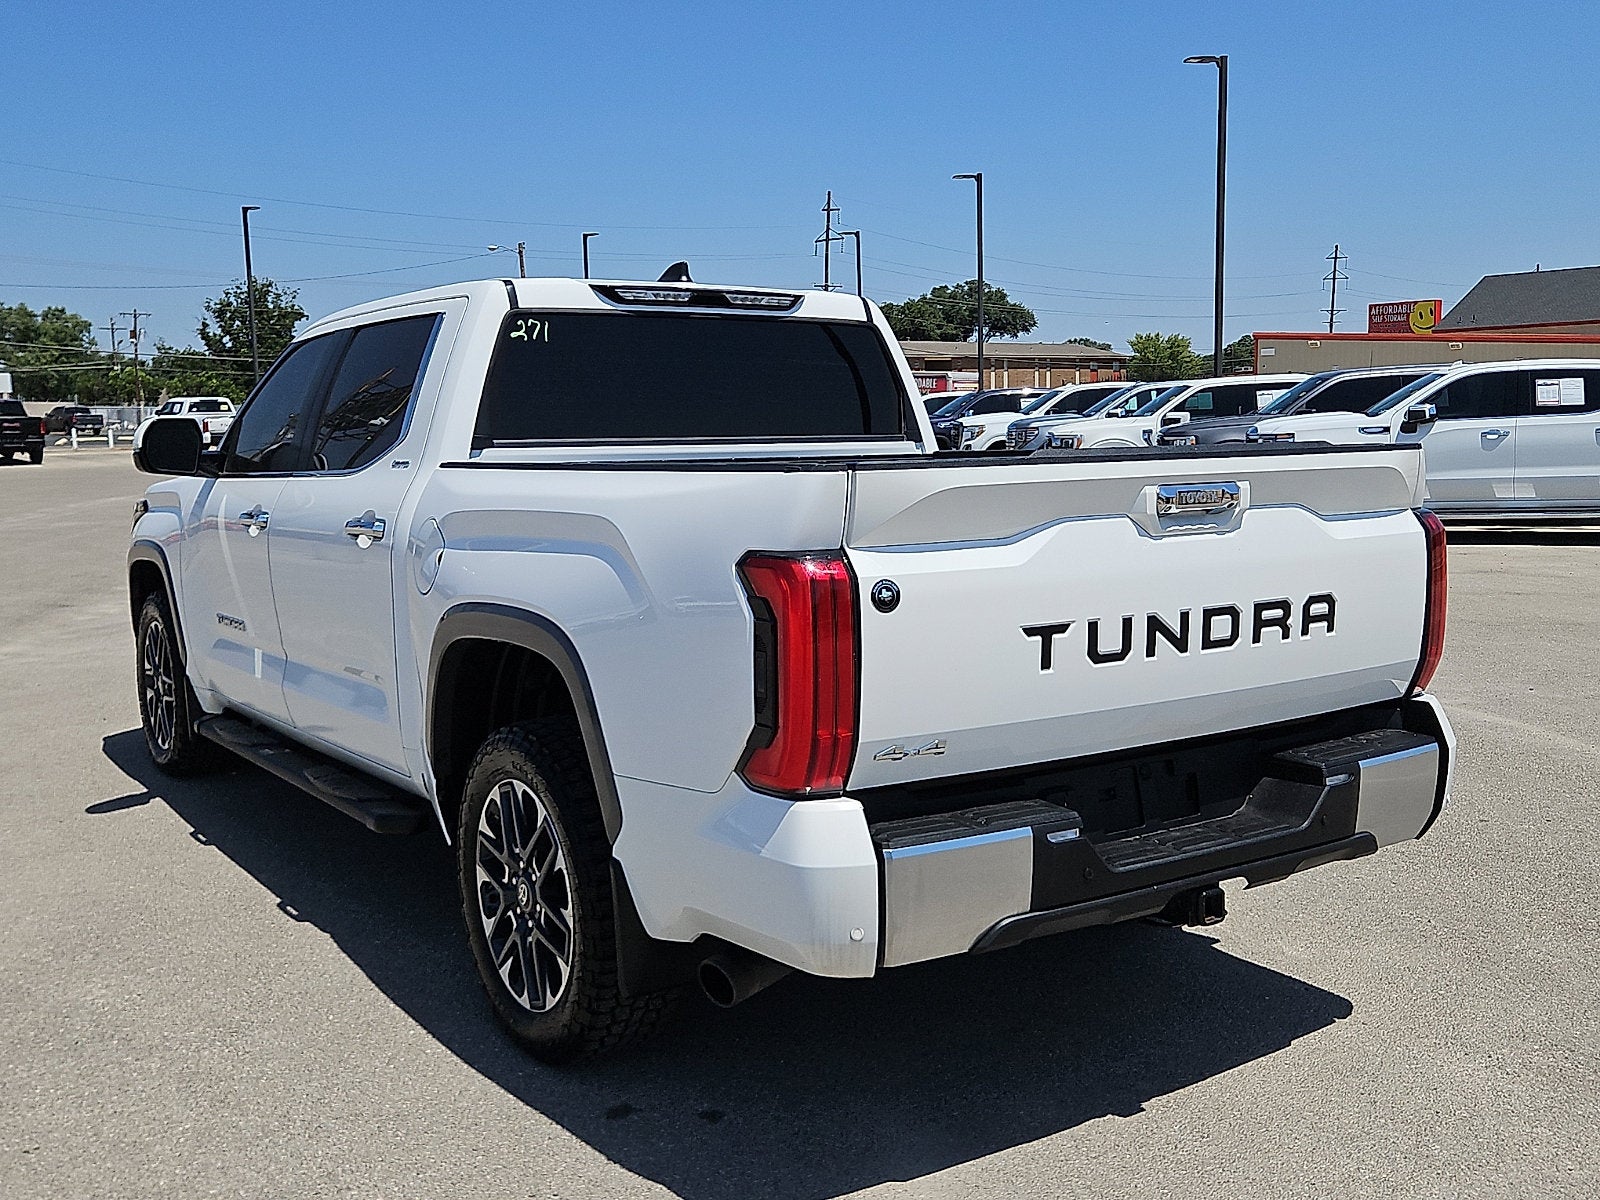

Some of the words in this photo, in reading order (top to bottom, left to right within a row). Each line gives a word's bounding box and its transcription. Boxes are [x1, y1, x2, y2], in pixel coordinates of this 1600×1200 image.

[1370, 303, 1415, 316] AFFORDABLE
[1371, 315, 1384, 323] SELF
[1384, 313, 1408, 322] STORAGE
[510, 318, 549, 342] 271
[1018, 591, 1339, 673] TUNDRA
